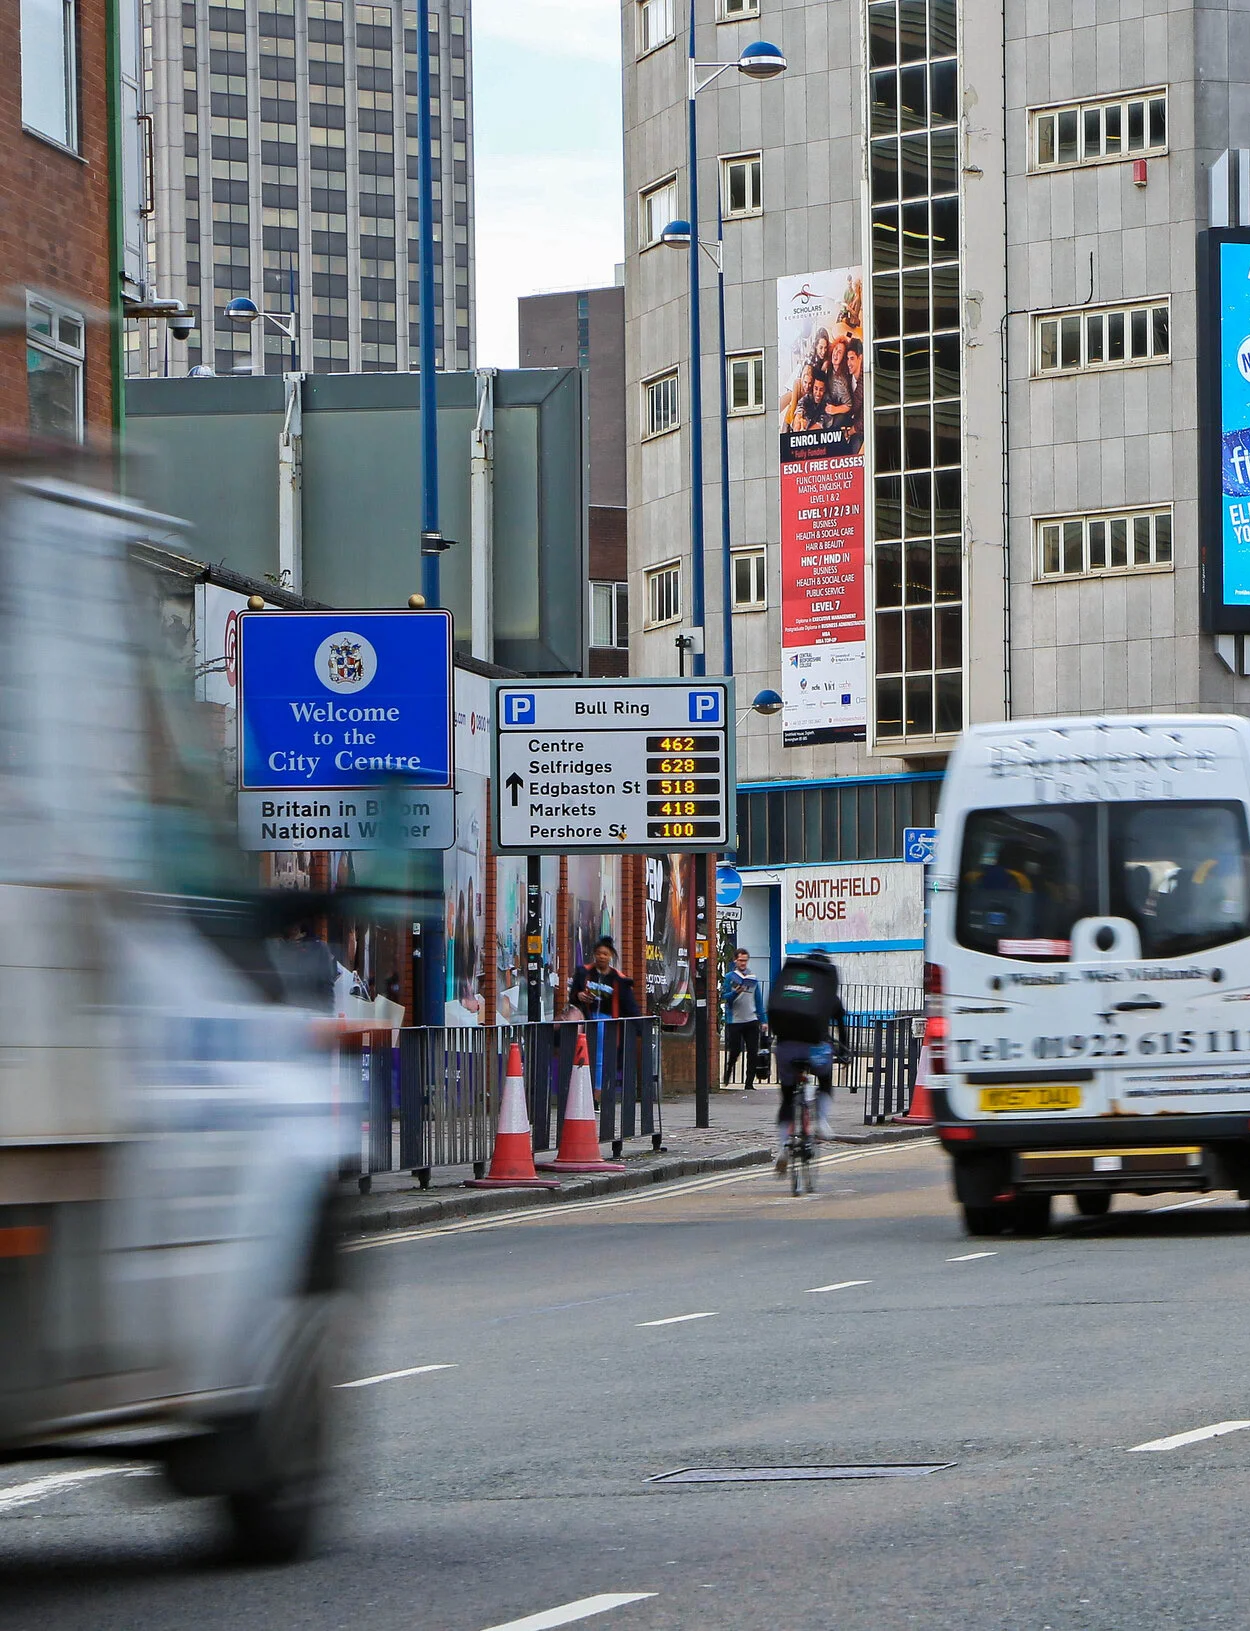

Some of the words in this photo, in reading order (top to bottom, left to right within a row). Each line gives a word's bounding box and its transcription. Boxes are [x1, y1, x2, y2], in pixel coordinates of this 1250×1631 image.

[793, 305, 822, 314] SCHOLARS
[790, 434, 818, 447] ENROL
[820, 431, 842, 442] NOW
[783, 463, 803, 475] ESOL
[796, 474, 833, 485] FUNCTIONAL
[834, 471, 853, 480] SKILLS
[798, 484, 818, 494] MATHS,
[843, 480, 852, 489] ICT
[810, 495, 825, 504] LEVEL
[798, 508, 821, 520] LEVEL
[822, 507, 827, 518] 1
[834, 506, 839, 516] 2
[845, 505, 850, 515] 3
[851, 504, 860, 515] IN
[812, 519, 837, 529] BUSINESS
[796, 531, 816, 541] HEALTH
[821, 529, 840, 538] SOCIAL
[840, 527, 855, 536] CARE
[805, 542, 819, 551] HAIR
[824, 539, 845, 550] BEAUTY
[801, 555, 818, 567] HNC
[823, 553, 841, 565] HND
[842, 552, 850, 563] IN
[813, 565, 838, 575] BUSINESS
[796, 578, 816, 587] HEALTH
[821, 575, 840, 585] SOCIAL
[841, 573, 855, 583] CARE
[806, 588, 824, 598] PUBLIC
[824, 586, 845, 596] SERVICE
[811, 601, 834, 612] LEVEL
[835, 600, 841, 610] 7
[289, 701, 400, 723] Welcome
[512, 697, 531, 722] P
[575, 701, 608, 715] Bull
[613, 701, 650, 716] Ring
[696, 695, 715, 720] P
[313, 731, 334, 745] to
[343, 728, 376, 745] the
[528, 738, 584, 753] Centre
[660, 737, 695, 751] 462
[268, 751, 320, 778] City
[334, 751, 421, 771] Centre
[528, 760, 612, 776] Selfridges
[661, 759, 695, 773] 628
[529, 782, 616, 798] Edgbaston
[621, 781, 641, 794] St
[661, 780, 695, 794] 518
[262, 801, 331, 818] Britain
[339, 801, 357, 817] in
[530, 803, 597, 817] Markets
[661, 801, 695, 815] 418
[262, 822, 350, 840] National
[530, 824, 602, 839] Pershore
[608, 823, 628, 838] St
[663, 823, 694, 837] 100
[795, 877, 881, 899] SMITHFIELD
[795, 901, 847, 921] HOUSE
[1080, 969, 1122, 983] West
[1126, 964, 1208, 981] Midlands
[953, 1037, 1023, 1062] Tel:
[1031, 1032, 1129, 1059] 01922
[1139, 1029, 1197, 1055] 615
